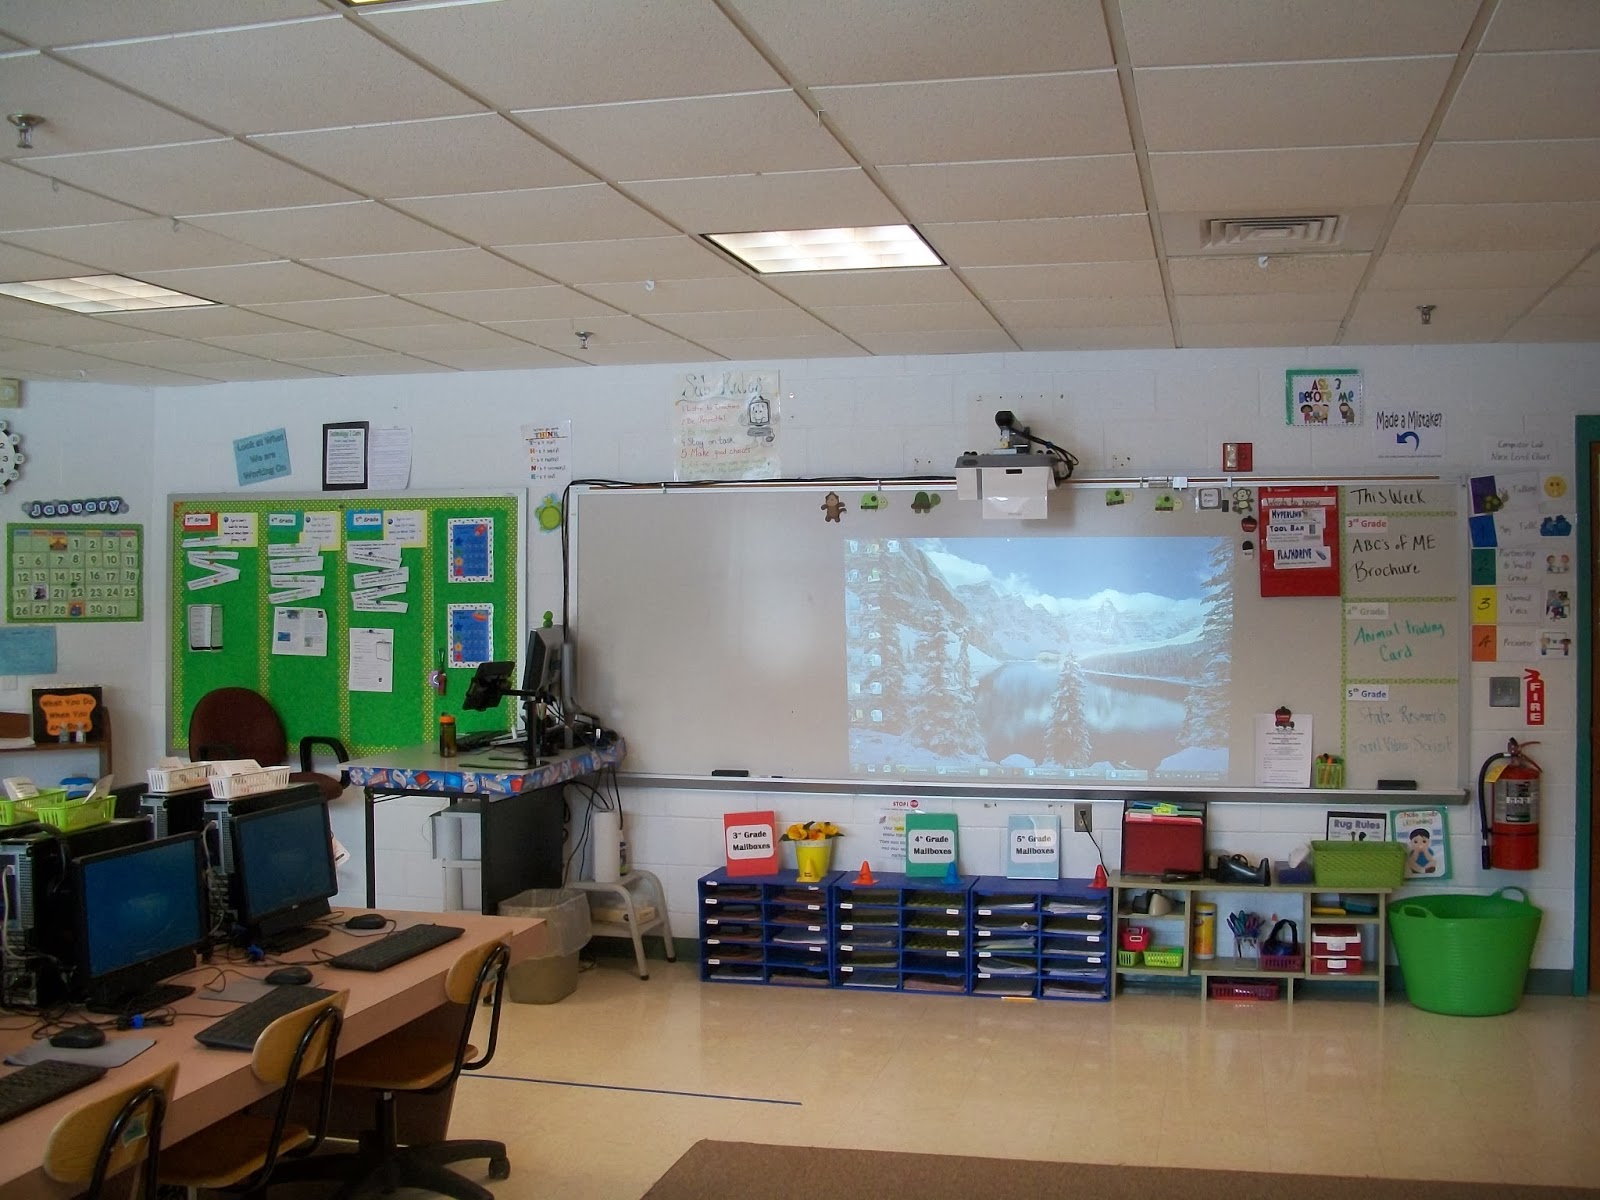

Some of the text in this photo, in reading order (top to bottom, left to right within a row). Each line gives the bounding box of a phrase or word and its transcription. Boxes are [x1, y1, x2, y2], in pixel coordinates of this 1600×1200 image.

[1335, 378, 1341, 389] 3
[1377, 411, 1442, 430] Made a Mistake?
[688, 438, 704, 448] Stay
[691, 447, 709, 457] Make
[1350, 488, 1426, 505] This Week
[32, 500, 120, 516] January
[1361, 520, 1387, 528] Grade
[127, 540, 133, 548] 4
[1396, 534, 1407, 550] of
[1413, 534, 1436, 551] ME
[18, 556, 24, 564] 5
[35, 557, 41, 565] 6
[72, 555, 79, 563] 8
[91, 556, 97, 564] 9
[107, 556, 117, 564] 10
[126, 557, 134, 565] 11
[18, 573, 29, 582] 12
[35, 573, 46, 581] 13
[71, 573, 81, 581] 15
[90, 571, 100, 580] 16
[126, 571, 136, 580] 18
[1353, 561, 1420, 582] Brochure
[16, 588, 136, 597] 19 21 22 23 24 25
[1478, 598, 1490, 610] 3
[16, 605, 117, 615] 26 27 28 30 31
[1478, 635, 1491, 648] 4
[1380, 644, 1412, 662] Card
[1348, 688, 1359, 697] 5th
[1530, 683, 1541, 721] FIRE
[1334, 819, 1381, 830] Rug Rules
[733, 843, 770, 851] Mailboxes
[1016, 847, 1054, 855] Mailboxes
